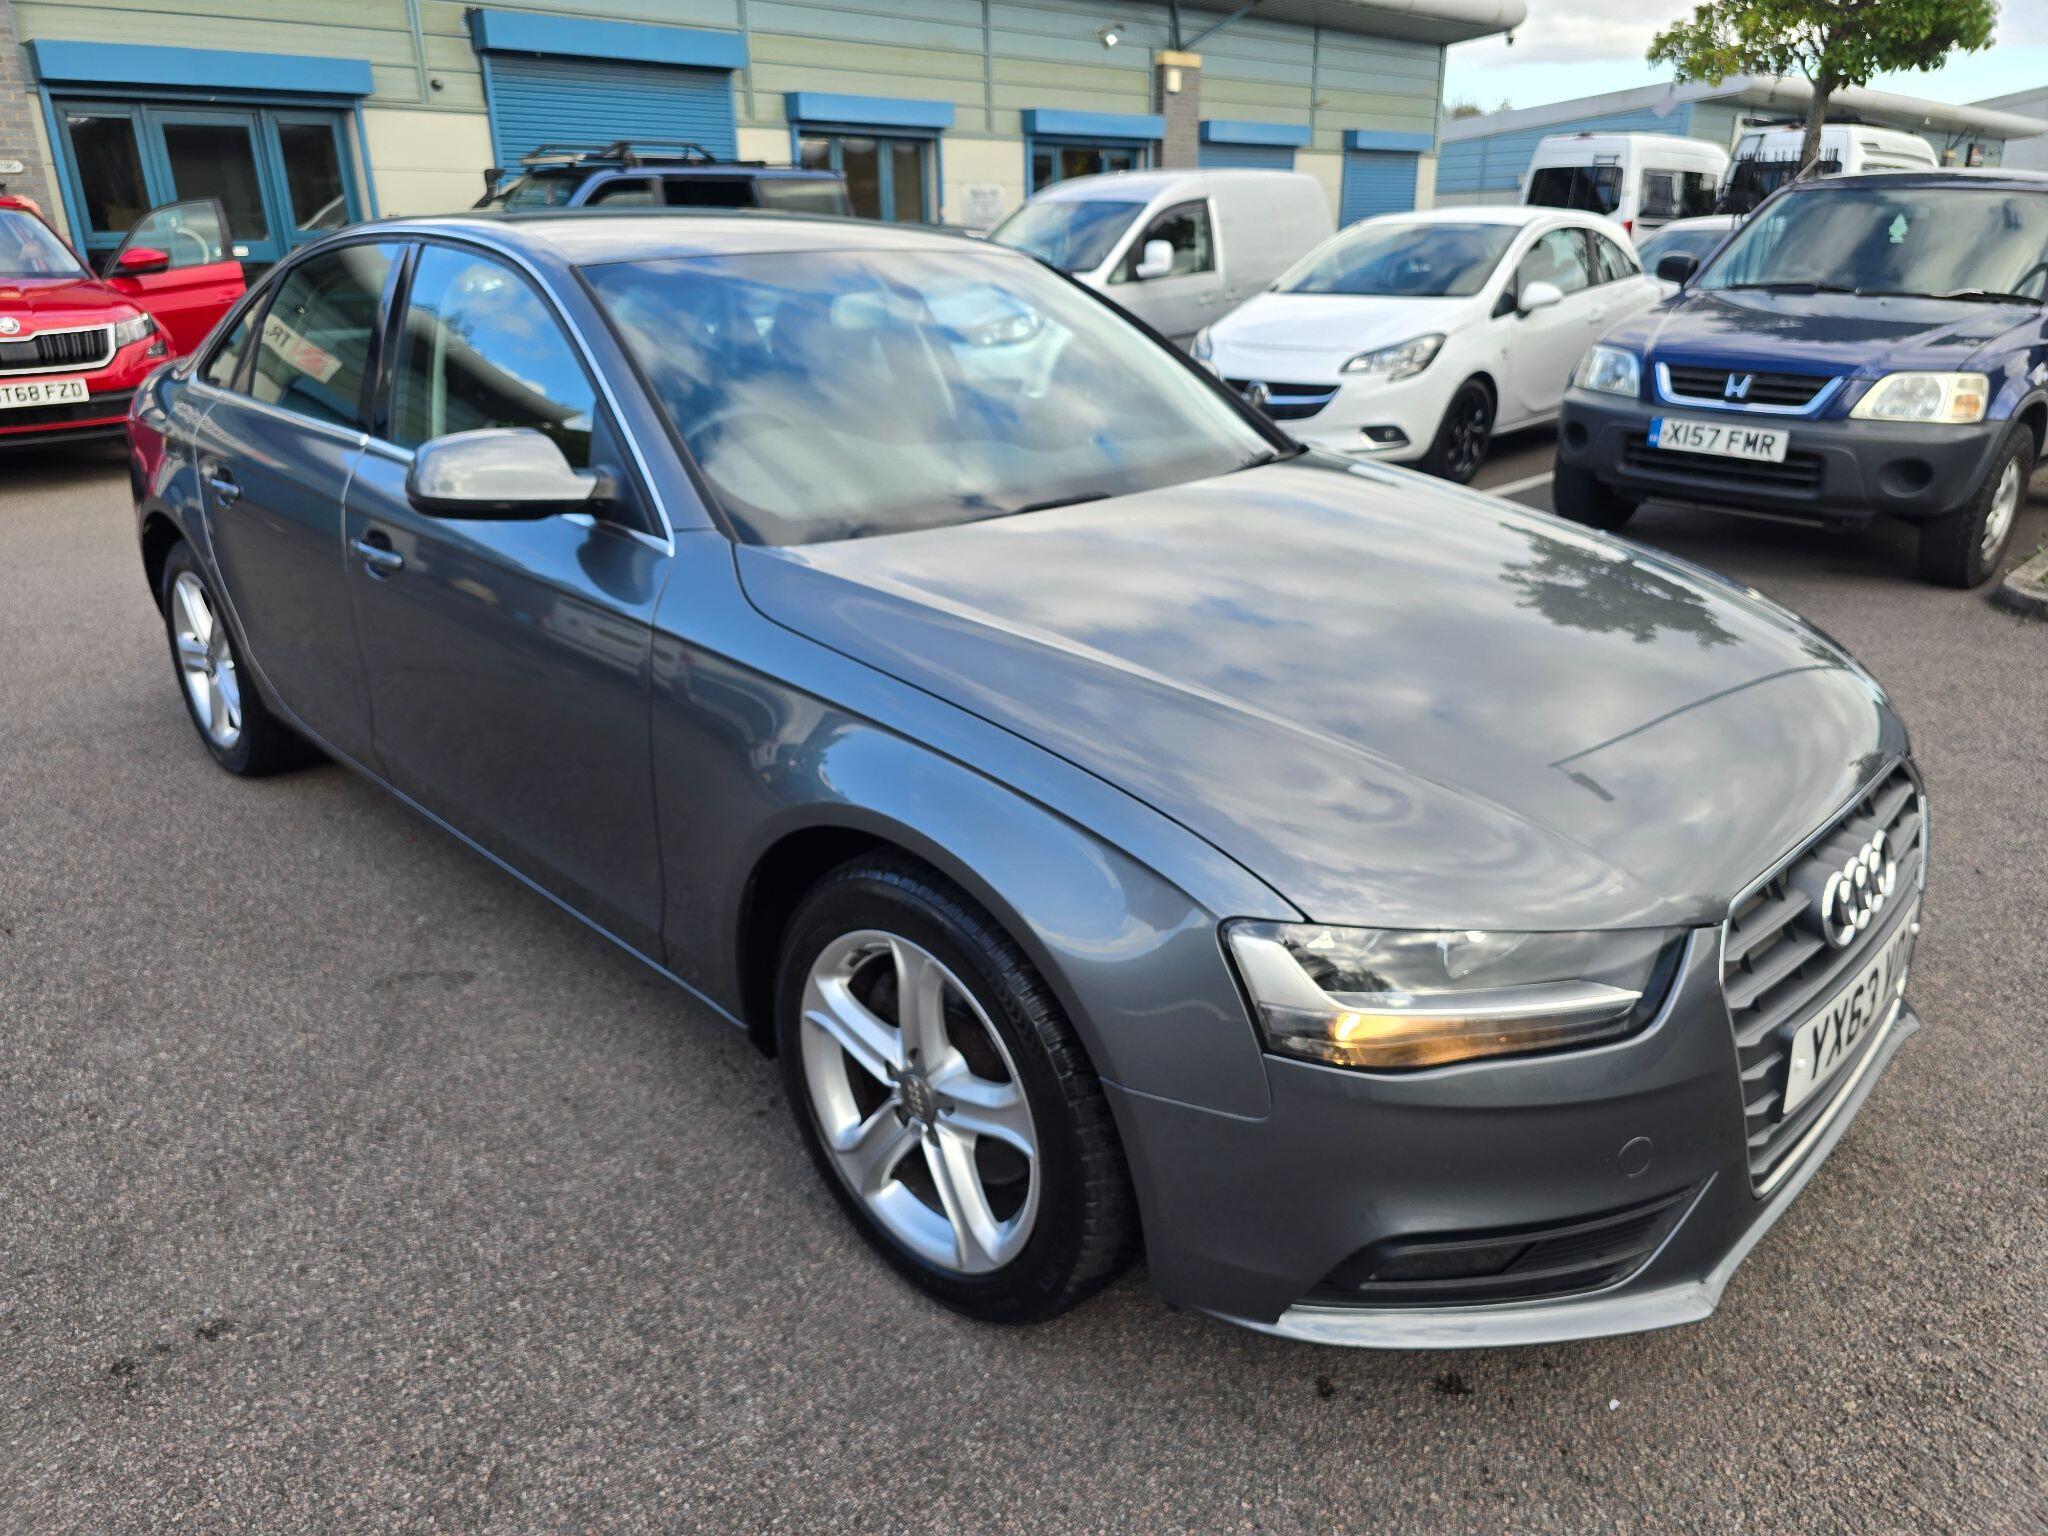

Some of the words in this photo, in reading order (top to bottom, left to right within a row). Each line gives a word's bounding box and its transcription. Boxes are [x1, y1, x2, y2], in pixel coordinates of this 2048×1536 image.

[0, 386, 40, 403] T68
[1726, 430, 1775, 457] FMR
[1811, 967, 1878, 1079] YX63
